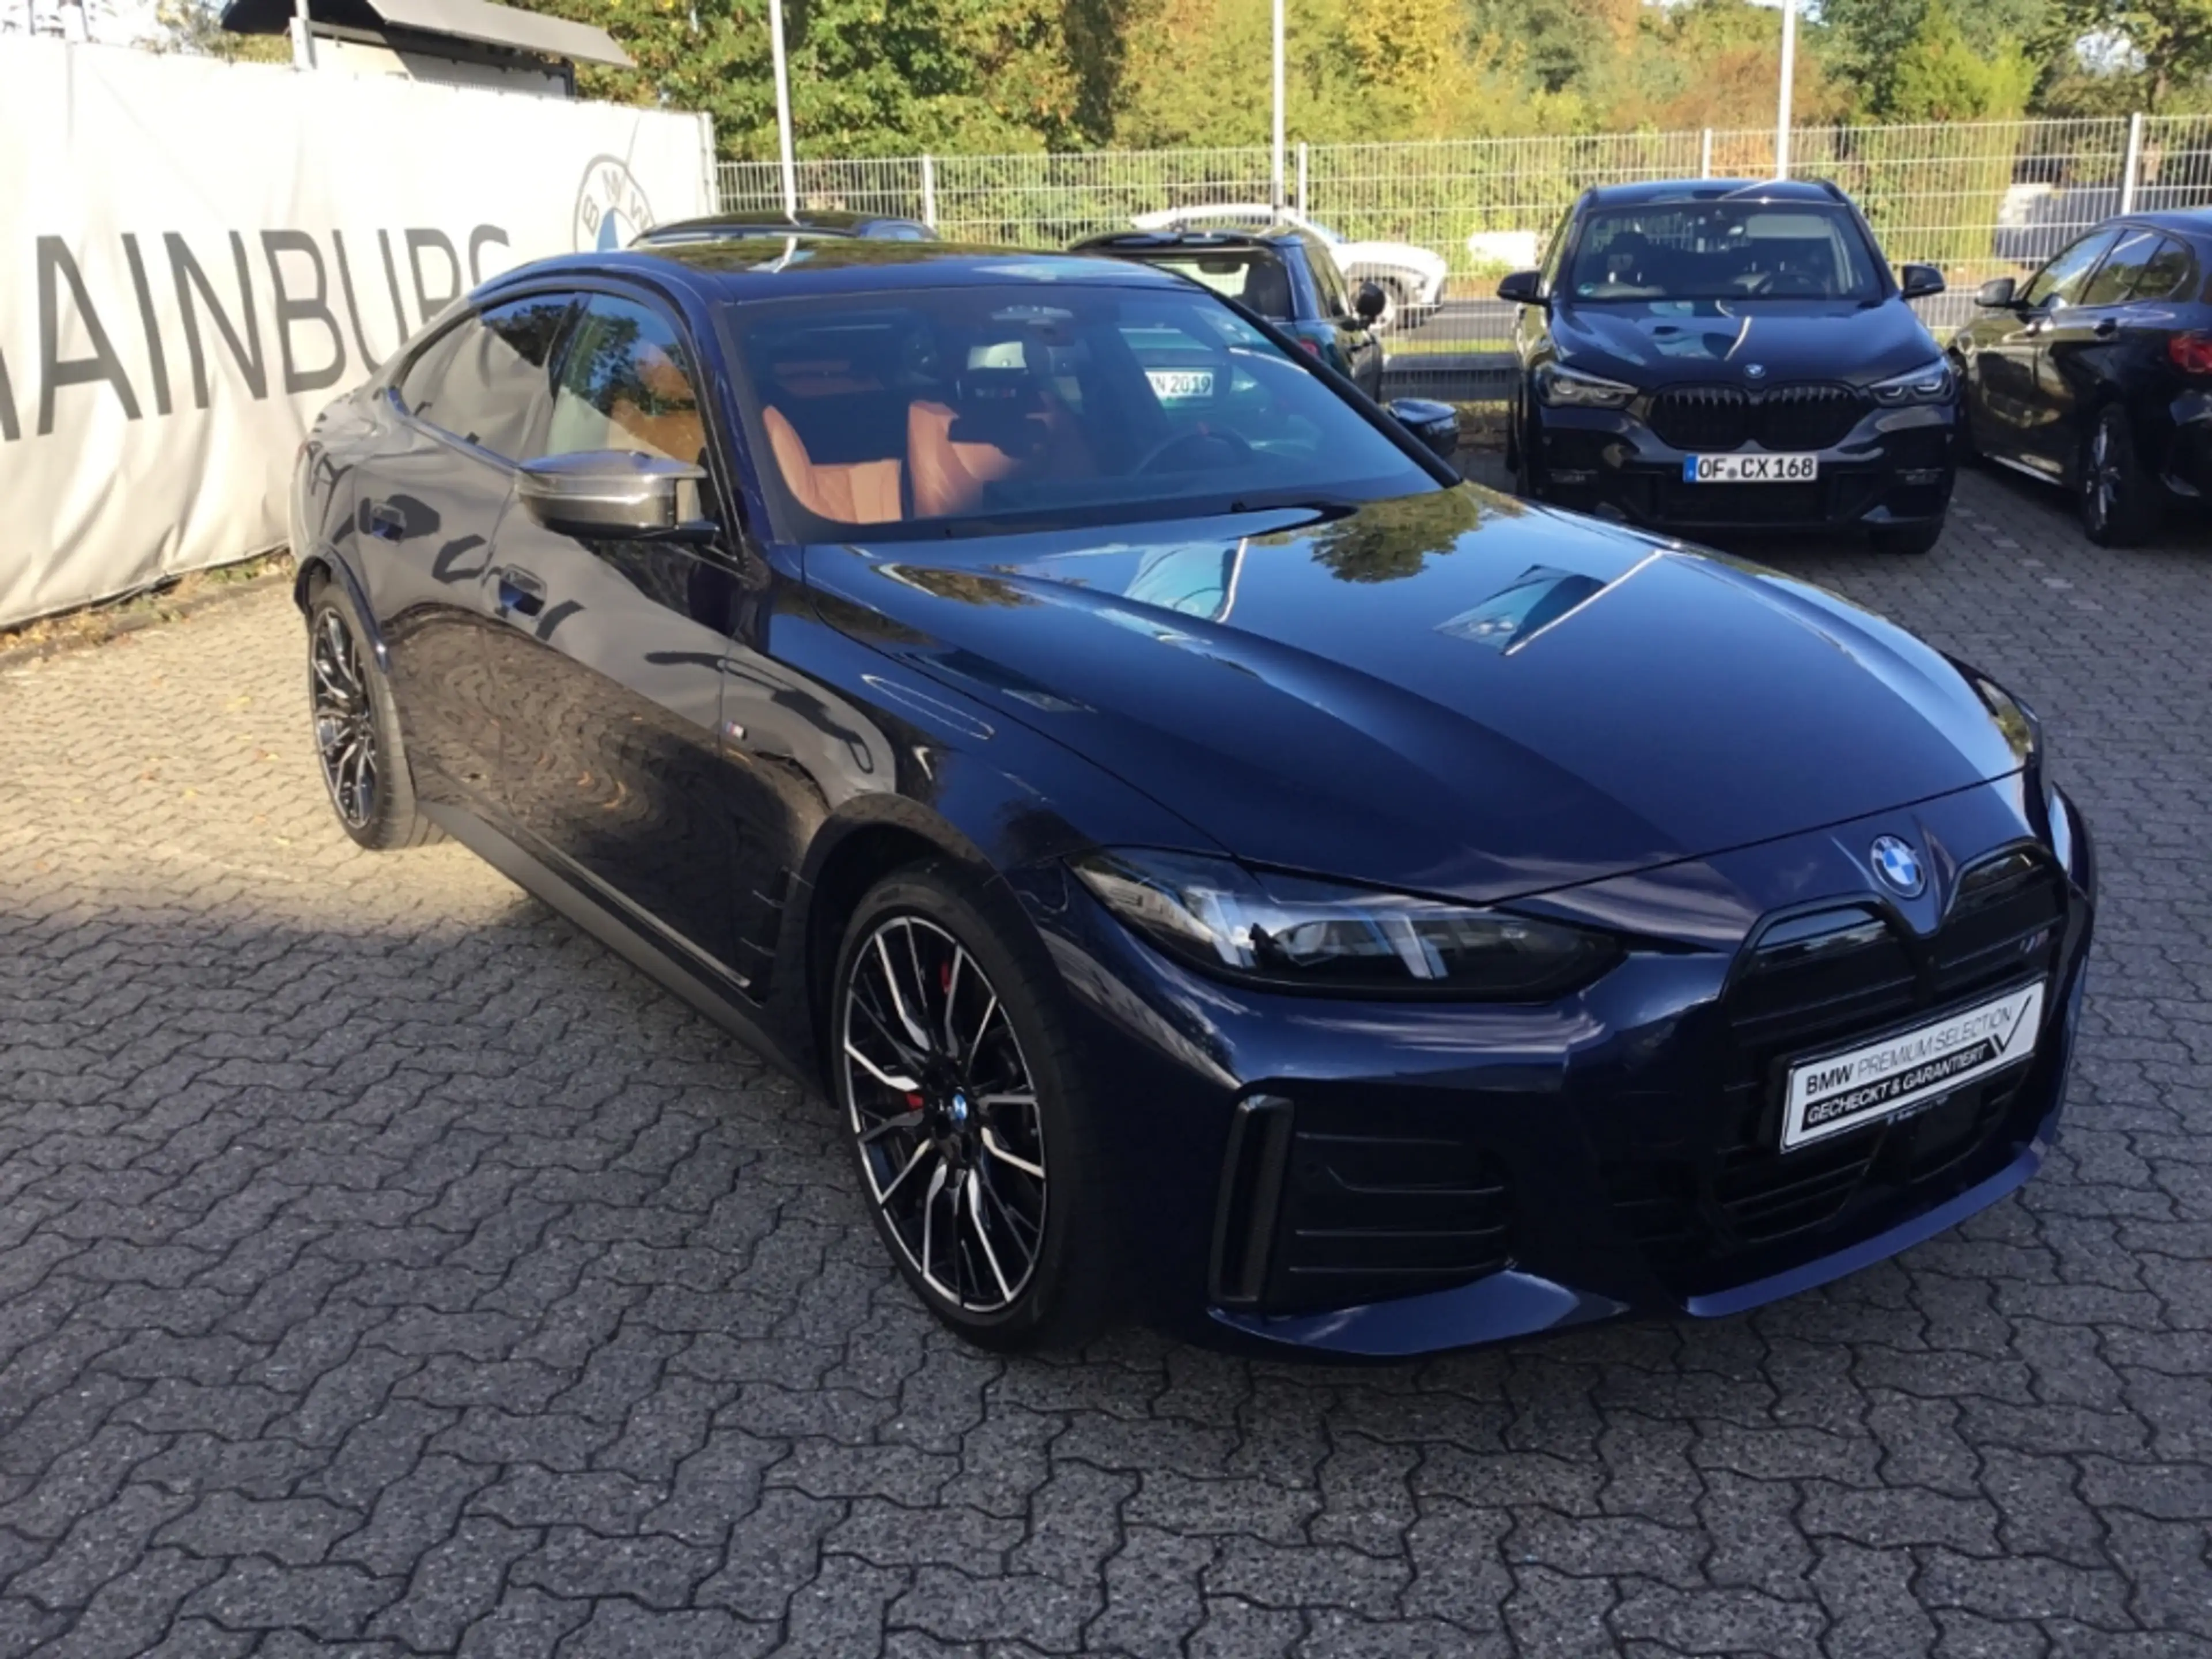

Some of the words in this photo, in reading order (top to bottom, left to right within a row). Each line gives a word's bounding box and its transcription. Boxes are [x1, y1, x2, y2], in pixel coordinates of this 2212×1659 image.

[582, 169, 649, 237] BMW
[1171, 375, 1210, 393] 2019
[1699, 458, 1726, 478] OF
[1806, 1063, 1854, 1096] BMW
[1857, 1036, 1934, 1079] PREMIUM
[1934, 1006, 2012, 1051] SELECTION
[1807, 1082, 1891, 1123] GECHECKT
[1889, 1077, 1901, 1094] &
[1902, 1043, 1988, 1090] GARANTIERT
